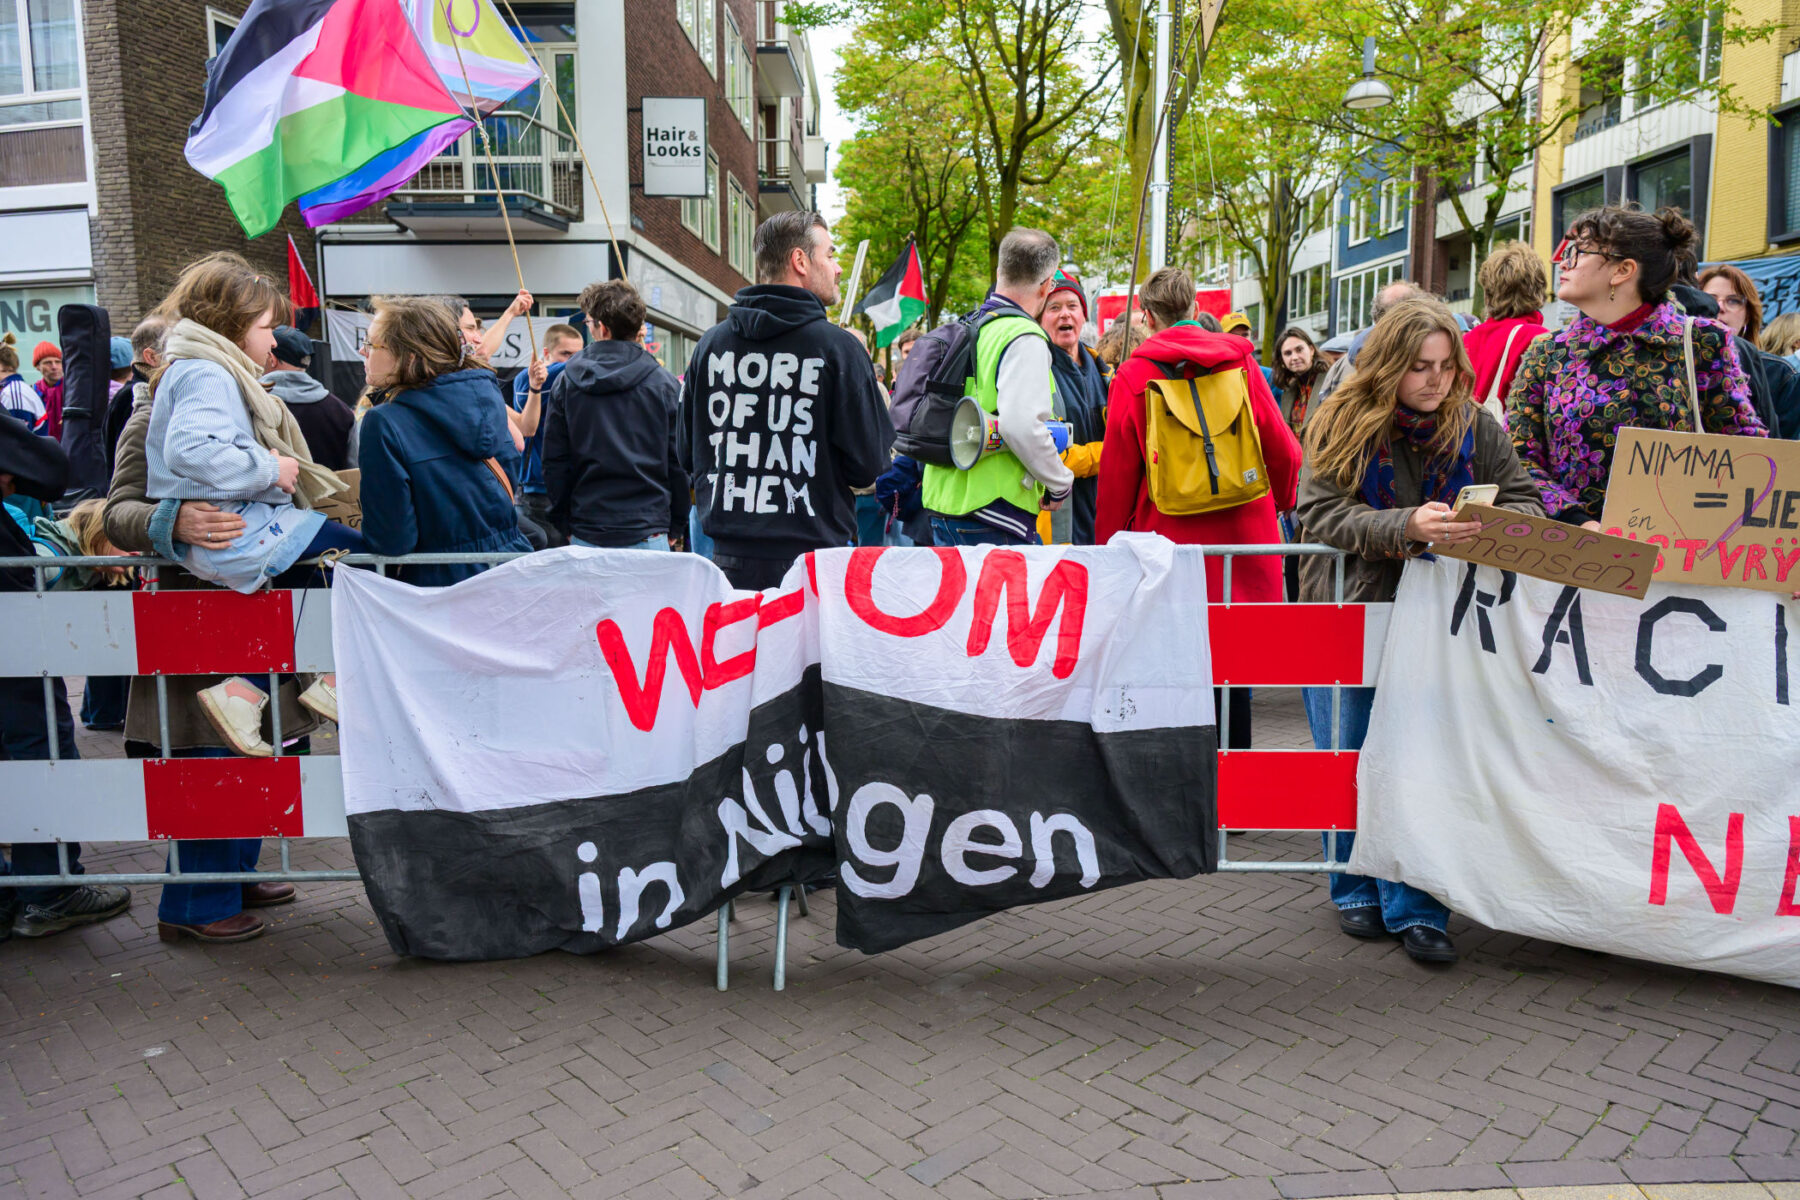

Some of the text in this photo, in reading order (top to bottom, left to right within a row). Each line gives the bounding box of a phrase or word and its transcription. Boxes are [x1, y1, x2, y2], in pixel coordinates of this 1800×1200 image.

[647, 142, 701, 157] Looks
[708, 351, 825, 395] MORE
[708, 391, 814, 435] OF US
[709, 431, 817, 478] THAN
[1628, 440, 1735, 480] NIMMA
[707, 472, 816, 517] THEM
[1742, 487, 1800, 529] LIE
[577, 841, 685, 940] in
